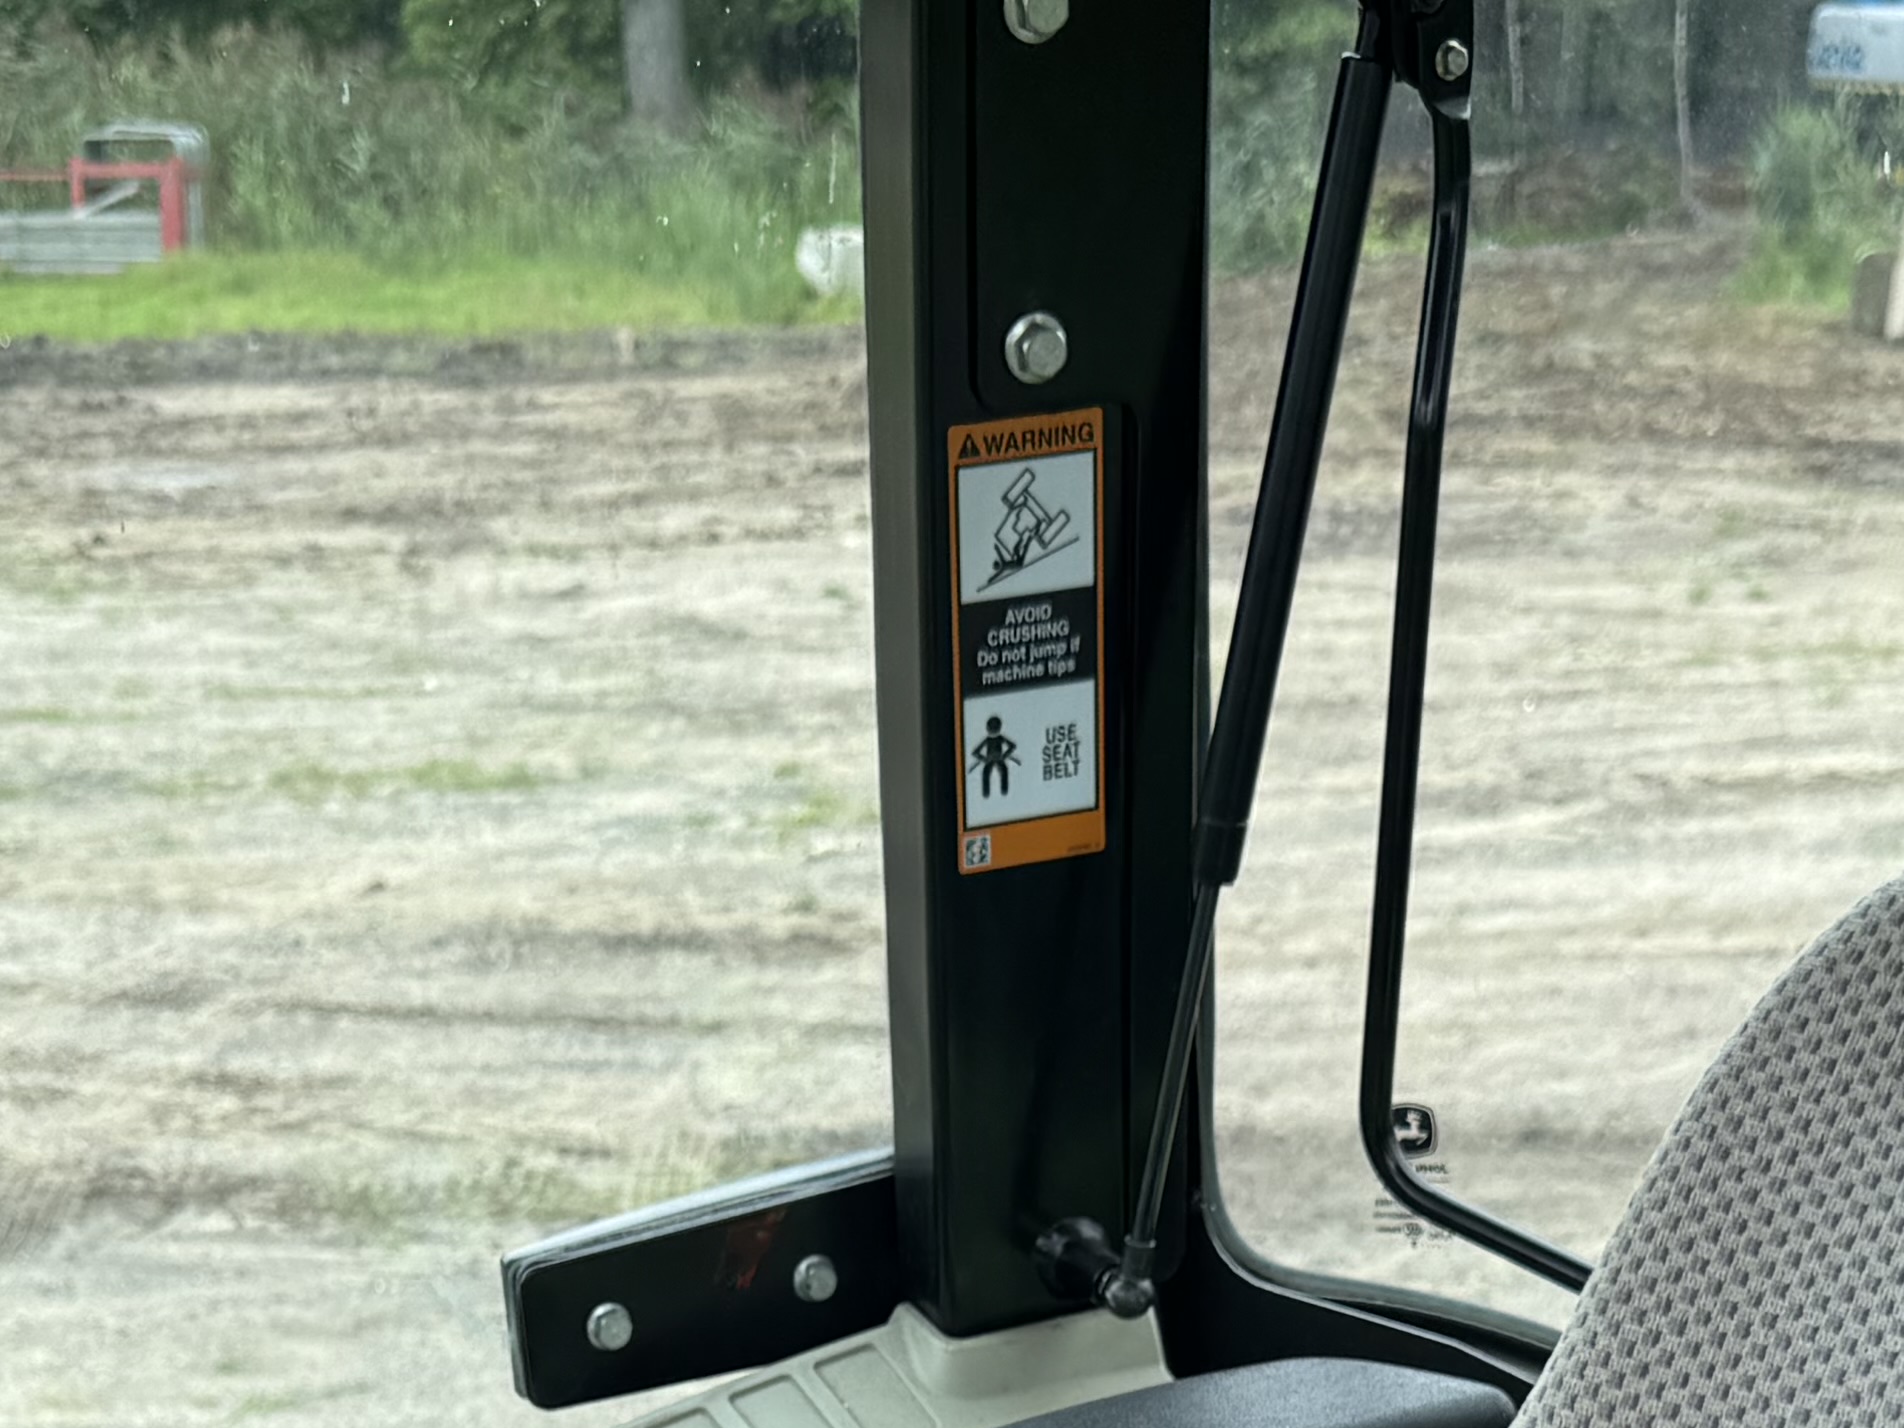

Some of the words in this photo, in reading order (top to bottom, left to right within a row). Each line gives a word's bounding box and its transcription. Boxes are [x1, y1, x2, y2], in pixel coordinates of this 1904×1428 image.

[983, 422, 1094, 456] WARNING
[1005, 604, 1052, 626] AVOID
[987, 619, 1070, 647] CRUSHING
[977, 650, 998, 667] Do
[1002, 646, 1026, 663] not
[1029, 641, 1067, 663] jump
[1070, 636, 1080, 653] if
[982, 663, 1045, 685] machine
[1048, 659, 1076, 677] tips
[1045, 724, 1077, 744] USE
[1042, 741, 1080, 763] SEAT
[1042, 759, 1080, 781] BELT
